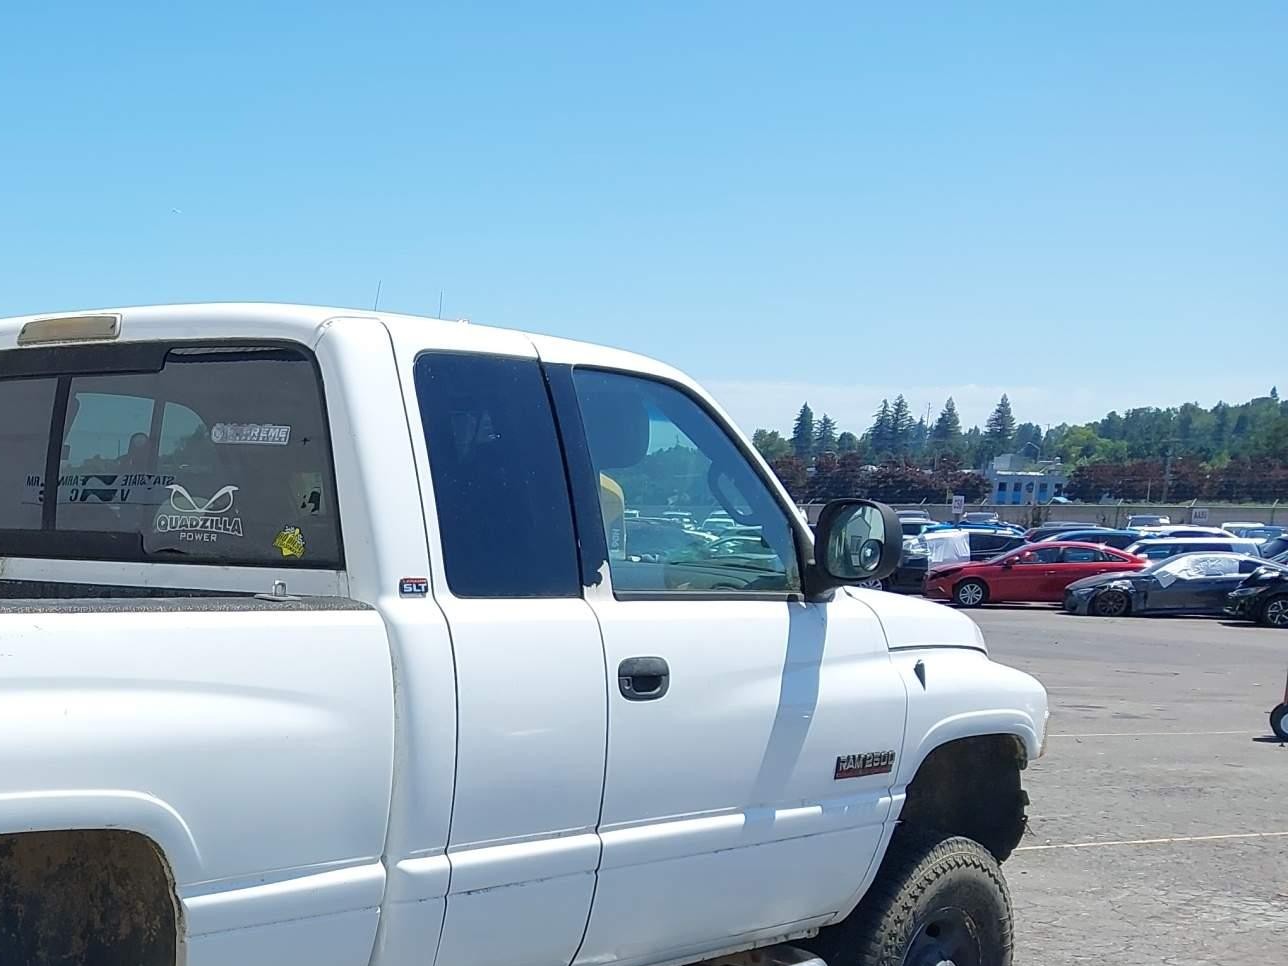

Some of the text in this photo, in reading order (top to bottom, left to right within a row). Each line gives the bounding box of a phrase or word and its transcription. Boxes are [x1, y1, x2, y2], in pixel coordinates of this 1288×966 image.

[157, 515, 243, 536] QUADZILLA
[180, 532, 217, 542] POWER
[403, 583, 427, 593] SLT
[839, 750, 896, 771] RAM 2500
